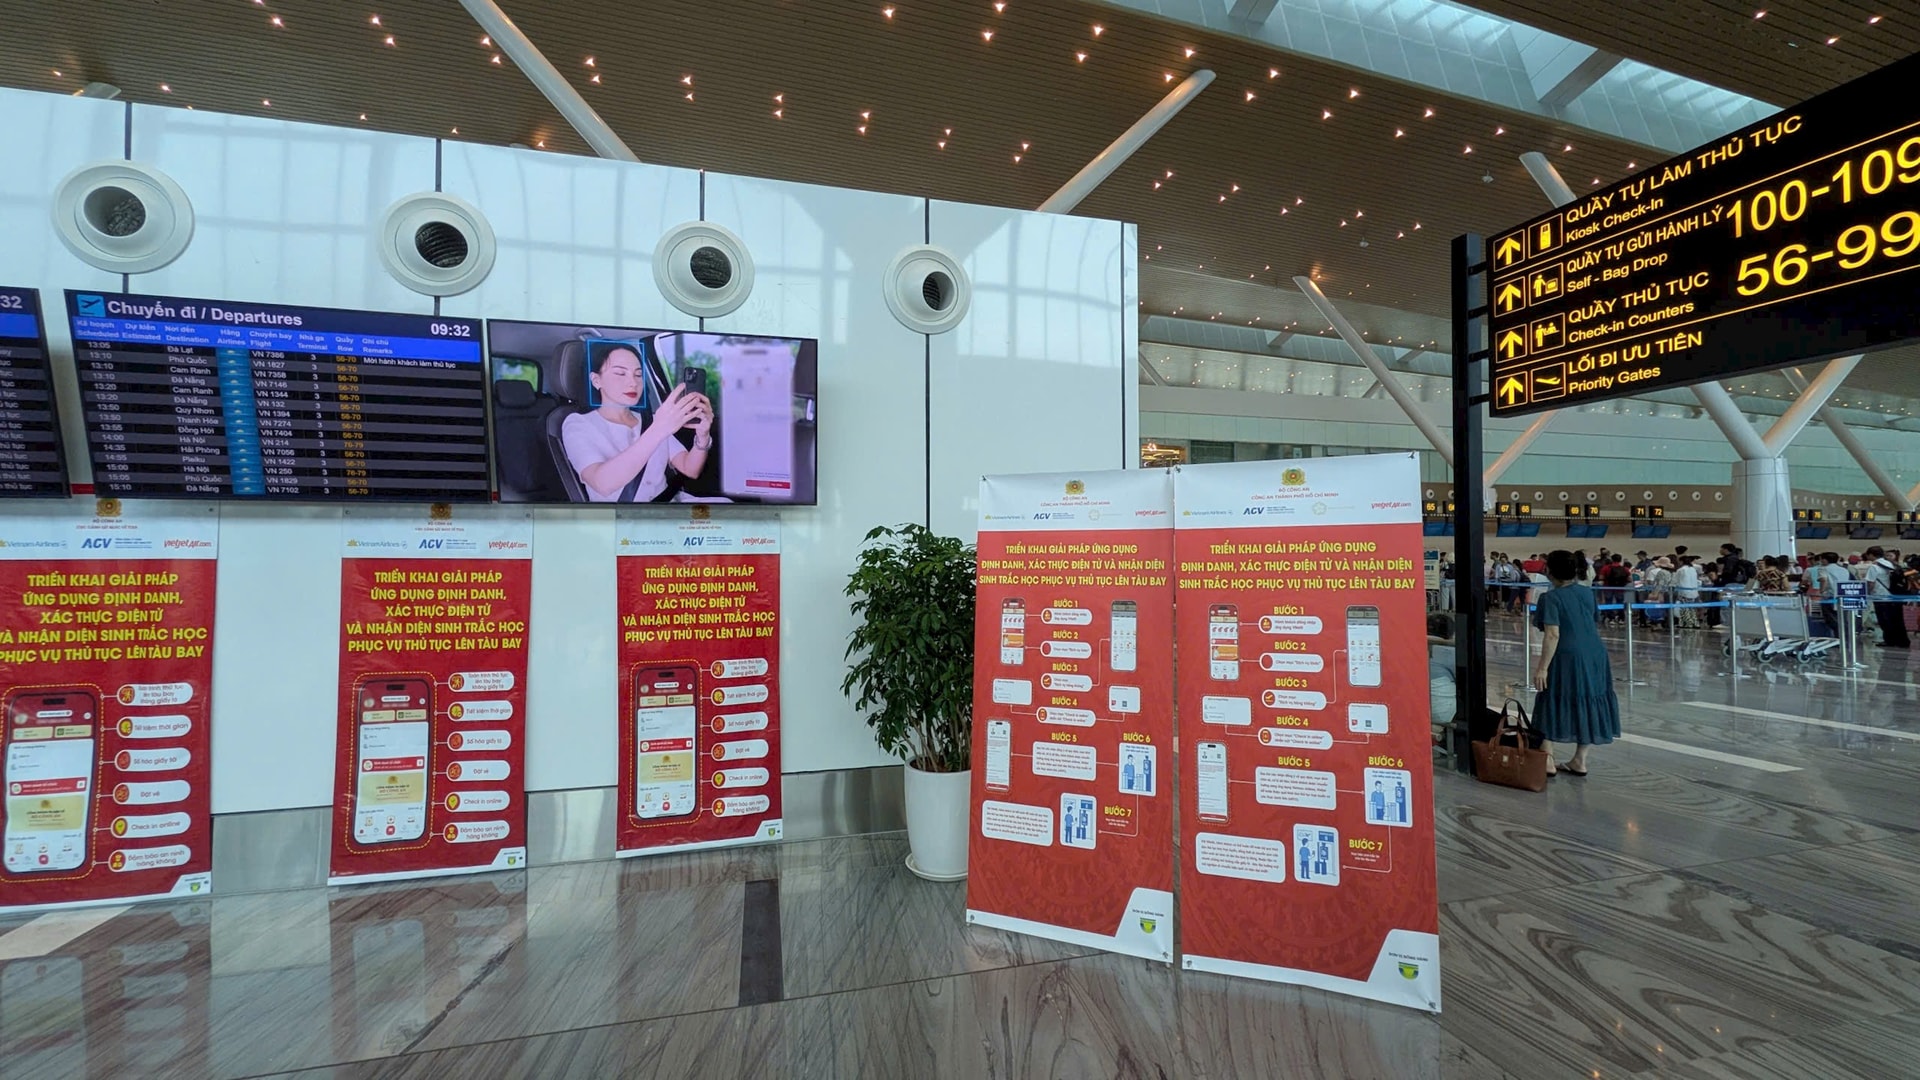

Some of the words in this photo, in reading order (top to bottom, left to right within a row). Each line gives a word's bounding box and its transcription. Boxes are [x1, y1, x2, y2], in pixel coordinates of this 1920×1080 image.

[1566, 193, 1614, 223] QUẦY
[1619, 179, 1646, 200] TỰ
[1650, 161, 1691, 190] LÀM
[1697, 137, 1743, 169] THỦ
[1750, 115, 1802, 147] TỤC
[1727, 136, 1920, 238] 100-109
[1566, 221, 1600, 243] Kiosk
[1603, 198, 1664, 228] Check-In
[1567, 250, 1602, 273] QUẦY
[1605, 241, 1624, 260] TỰ
[1627, 232, 1652, 252] GỬI
[1656, 216, 1699, 243] HÀNH
[1703, 204, 1723, 226] LÝ
[1737, 211, 1920, 296] 56-99
[1567, 275, 1592, 293] Self
[1603, 265, 1629, 281] Bag
[1633, 252, 1668, 271] Drop
[1568, 298, 1617, 323] QUẦY
[1621, 283, 1661, 308] THỦ
[1666, 272, 1709, 295] TỤC
[108, 301, 175, 318] Chuyến
[181, 307, 196, 319] đi
[211, 308, 303, 326] Departures
[431, 323, 470, 337] 09:32
[1569, 320, 1624, 343] Check-in
[1628, 302, 1694, 327] Counters
[166, 334, 209, 344] Destination
[217, 338, 246, 346] Airlines
[250, 340, 272, 348] Flight
[298, 342, 328, 351] Terminal
[1568, 353, 1595, 374] LỐI
[1599, 351, 1617, 367] ĐI
[1623, 343, 1650, 362] ƯU
[1655, 331, 1702, 354] TIÊN
[190, 367, 211, 375] Ranh
[254, 370, 266, 378] VN
[1569, 376, 1614, 393] Priority
[1618, 367, 1661, 383] Gates
[1243, 507, 1264, 515] ACV
[419, 539, 443, 549] ACV
[1006, 541, 1026, 554] TRIỂN
[1028, 545, 1047, 554] KHAI
[1049, 543, 1066, 553] GIẢI
[1069, 543, 1090, 553] PHÁP
[1092, 542, 1110, 553] ỨNG
[1113, 545, 1137, 555] DỤNG
[1210, 539, 1237, 554] TRIỂN
[1239, 544, 1262, 554] KHAI
[1265, 541, 1287, 554] GIẢI
[1289, 541, 1315, 553] PHÁP
[1319, 540, 1342, 553] ỨNG
[1345, 542, 1376, 554] DỤNG
[645, 564, 673, 578] TRIỂN
[676, 568, 700, 578] KHAI
[703, 566, 725, 577] GIẢI
[728, 564, 755, 576] PHÁP
[1181, 562, 1204, 573] ĐỊNH
[1207, 561, 1237, 573] DANH,
[1240, 559, 1262, 571] XÁC
[1264, 560, 1290, 573] THỰC
[1293, 560, 1317, 573] ĐIỆN
[1320, 557, 1333, 570] TỬ
[1335, 559, 1350, 570] VÀ
[1353, 560, 1384, 573] NHẬN
[1388, 557, 1412, 571] DIỆN
[28, 571, 66, 587] TRIỂN
[70, 575, 105, 586] KHAI
[109, 572, 141, 586] GIẢI
[144, 571, 179, 585] PHÁP
[374, 568, 406, 583] TRIỂN
[410, 572, 438, 583] KHAI
[442, 570, 467, 583] GIẢI
[471, 570, 502, 583] PHÁP
[1180, 579, 1201, 588] SINH
[1203, 575, 1228, 588] TRẮC
[1231, 579, 1253, 590] HỌC
[1256, 579, 1284, 590] PHỤC
[1287, 579, 1300, 590] VỤ
[1304, 576, 1322, 588] THỦ
[1325, 578, 1346, 590] TỤC
[1349, 576, 1367, 588] LÊN
[1370, 576, 1391, 588] TÀU
[1395, 578, 1416, 588] BAY
[371, 587, 397, 600] ỨNG
[401, 589, 434, 602] DỤNG
[438, 589, 467, 603] ĐỊNH
[471, 589, 506, 600] DANH,
[386, 603, 411, 616] XÁC
[414, 605, 444, 618] THỰC
[448, 603, 475, 618] ĐIỆN
[478, 603, 491, 616] TỬ
[1274, 606, 1298, 615] BƯỚC
[1300, 607, 1304, 615] 1
[346, 622, 362, 634] VÀ
[367, 622, 403, 636] NHẬN
[406, 621, 432, 636] DIỆN
[435, 622, 462, 634] SINH
[465, 618, 495, 633] TRẮC
[499, 622, 524, 634] HỌC
[348, 640, 384, 653] PHỤC
[386, 640, 401, 653] VỤ
[406, 637, 427, 651] THỦ
[429, 639, 451, 652] TỤC
[455, 637, 475, 650] LÊN
[478, 637, 498, 649] TÀU
[502, 639, 521, 649] BAY
[1368, 756, 1395, 767] BƯỚC
[1397, 758, 1403, 767] 6
[1349, 838, 1375, 850] BƯỚC
[1377, 842, 1382, 851] 7
